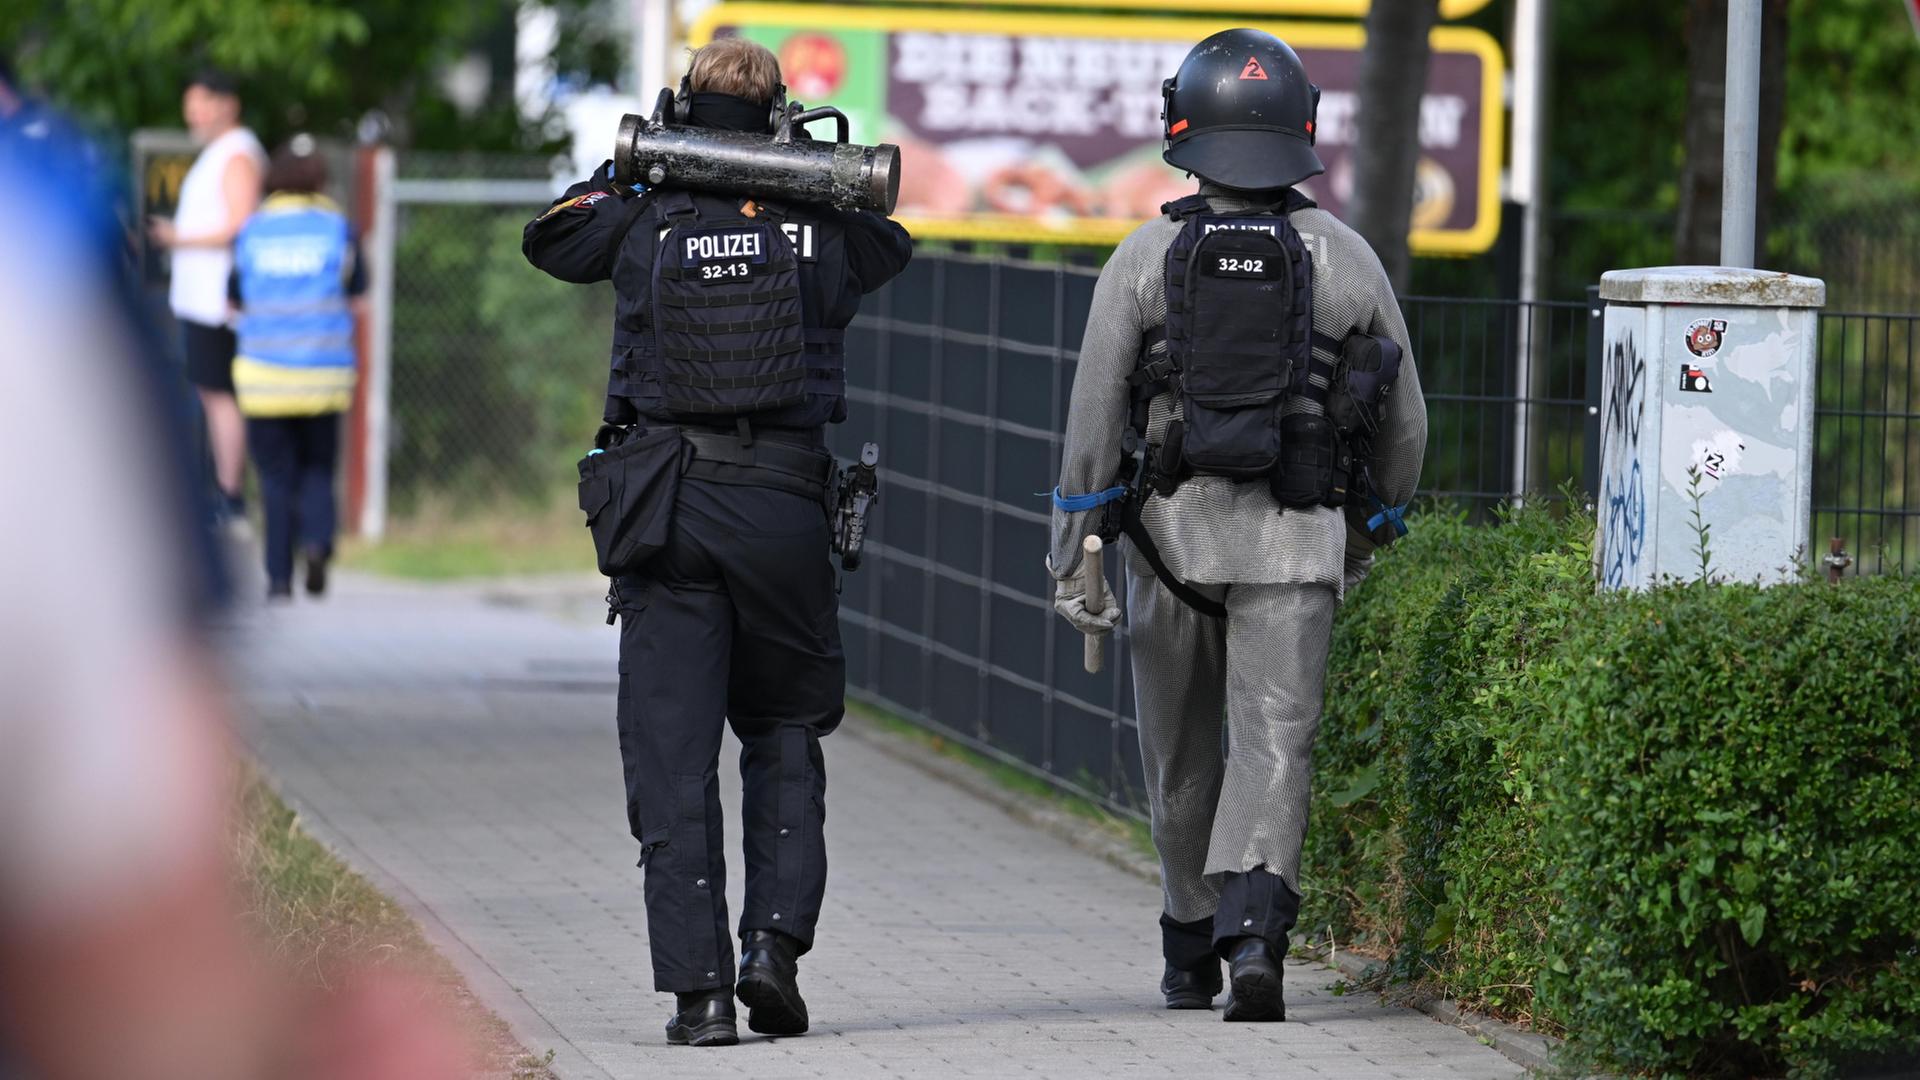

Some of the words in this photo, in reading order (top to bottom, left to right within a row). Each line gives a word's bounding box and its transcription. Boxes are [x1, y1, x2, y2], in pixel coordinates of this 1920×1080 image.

[686, 233, 760, 260] POLIZEI
[701, 262, 749, 280] 32-13
[1218, 257, 1264, 273] 32-02
